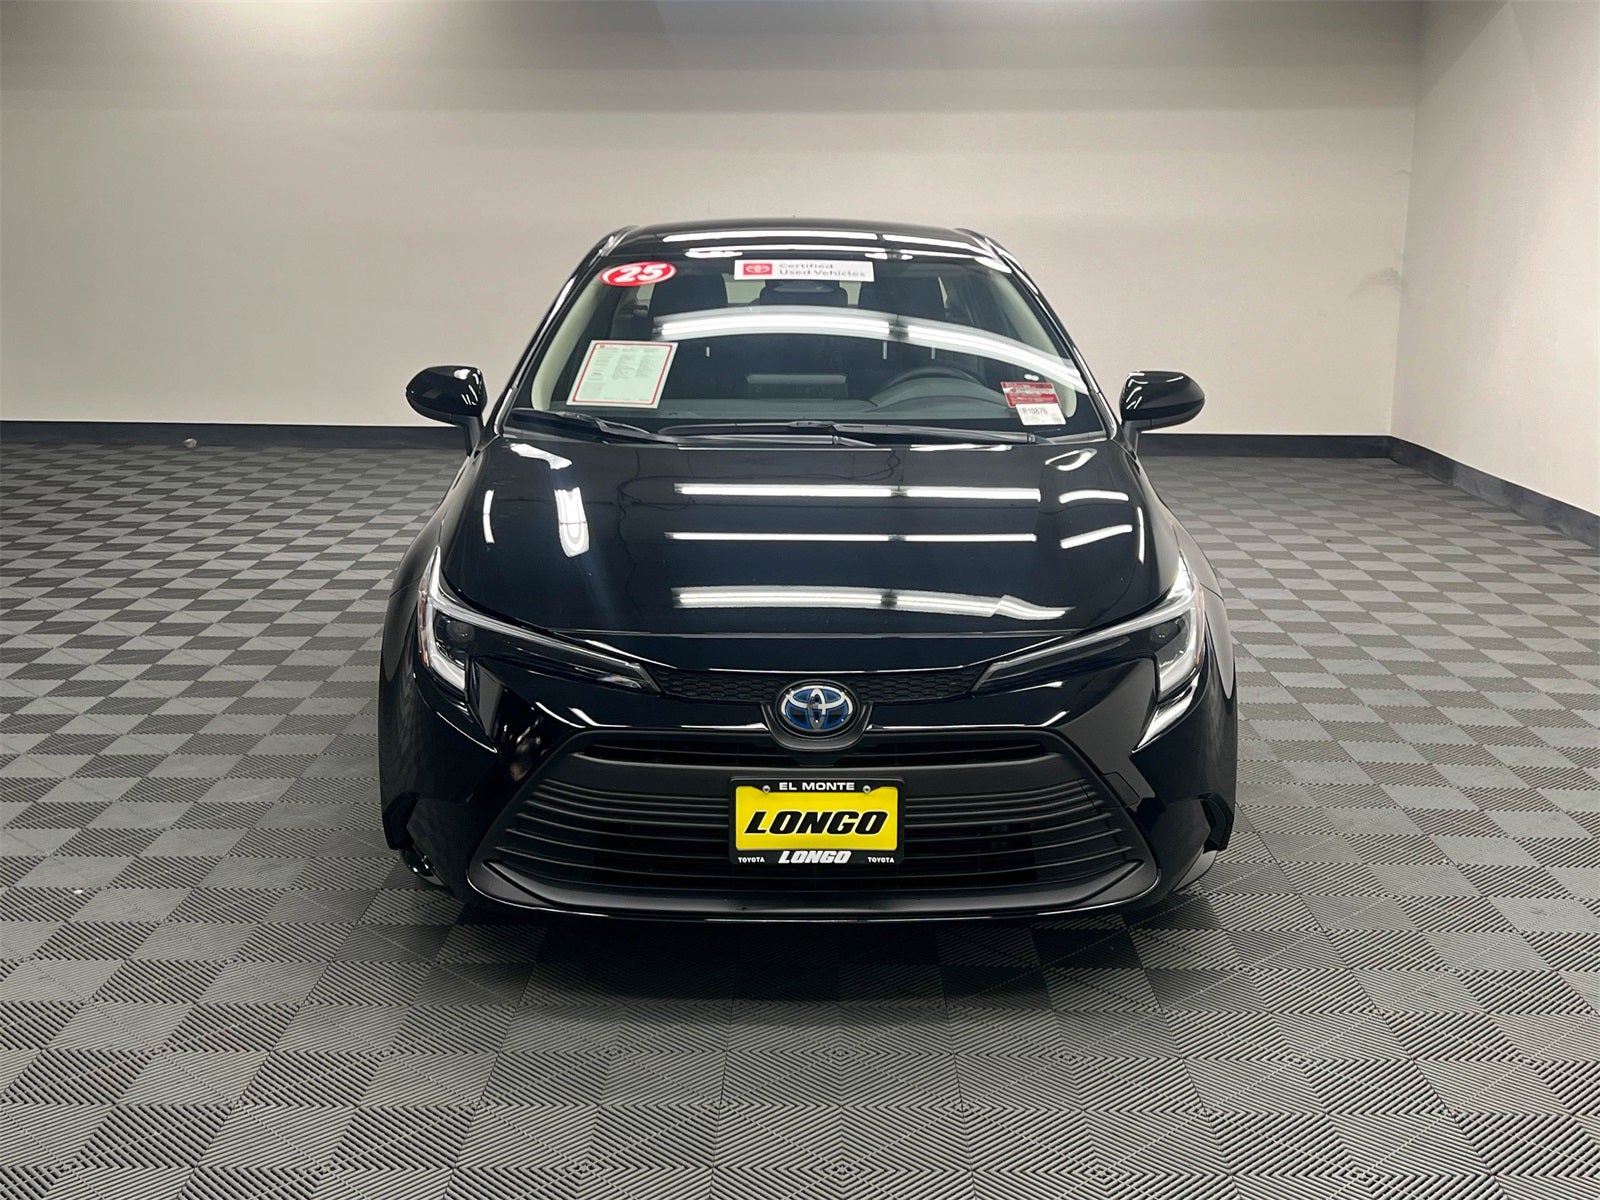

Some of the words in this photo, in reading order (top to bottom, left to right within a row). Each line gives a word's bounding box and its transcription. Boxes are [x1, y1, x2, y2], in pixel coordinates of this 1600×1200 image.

[614, 263, 668, 283] 25
[779, 782, 797, 791] EL
[802, 782, 855, 791] MONTE
[744, 811, 888, 835] LONGO
[778, 850, 852, 864] LONGO
